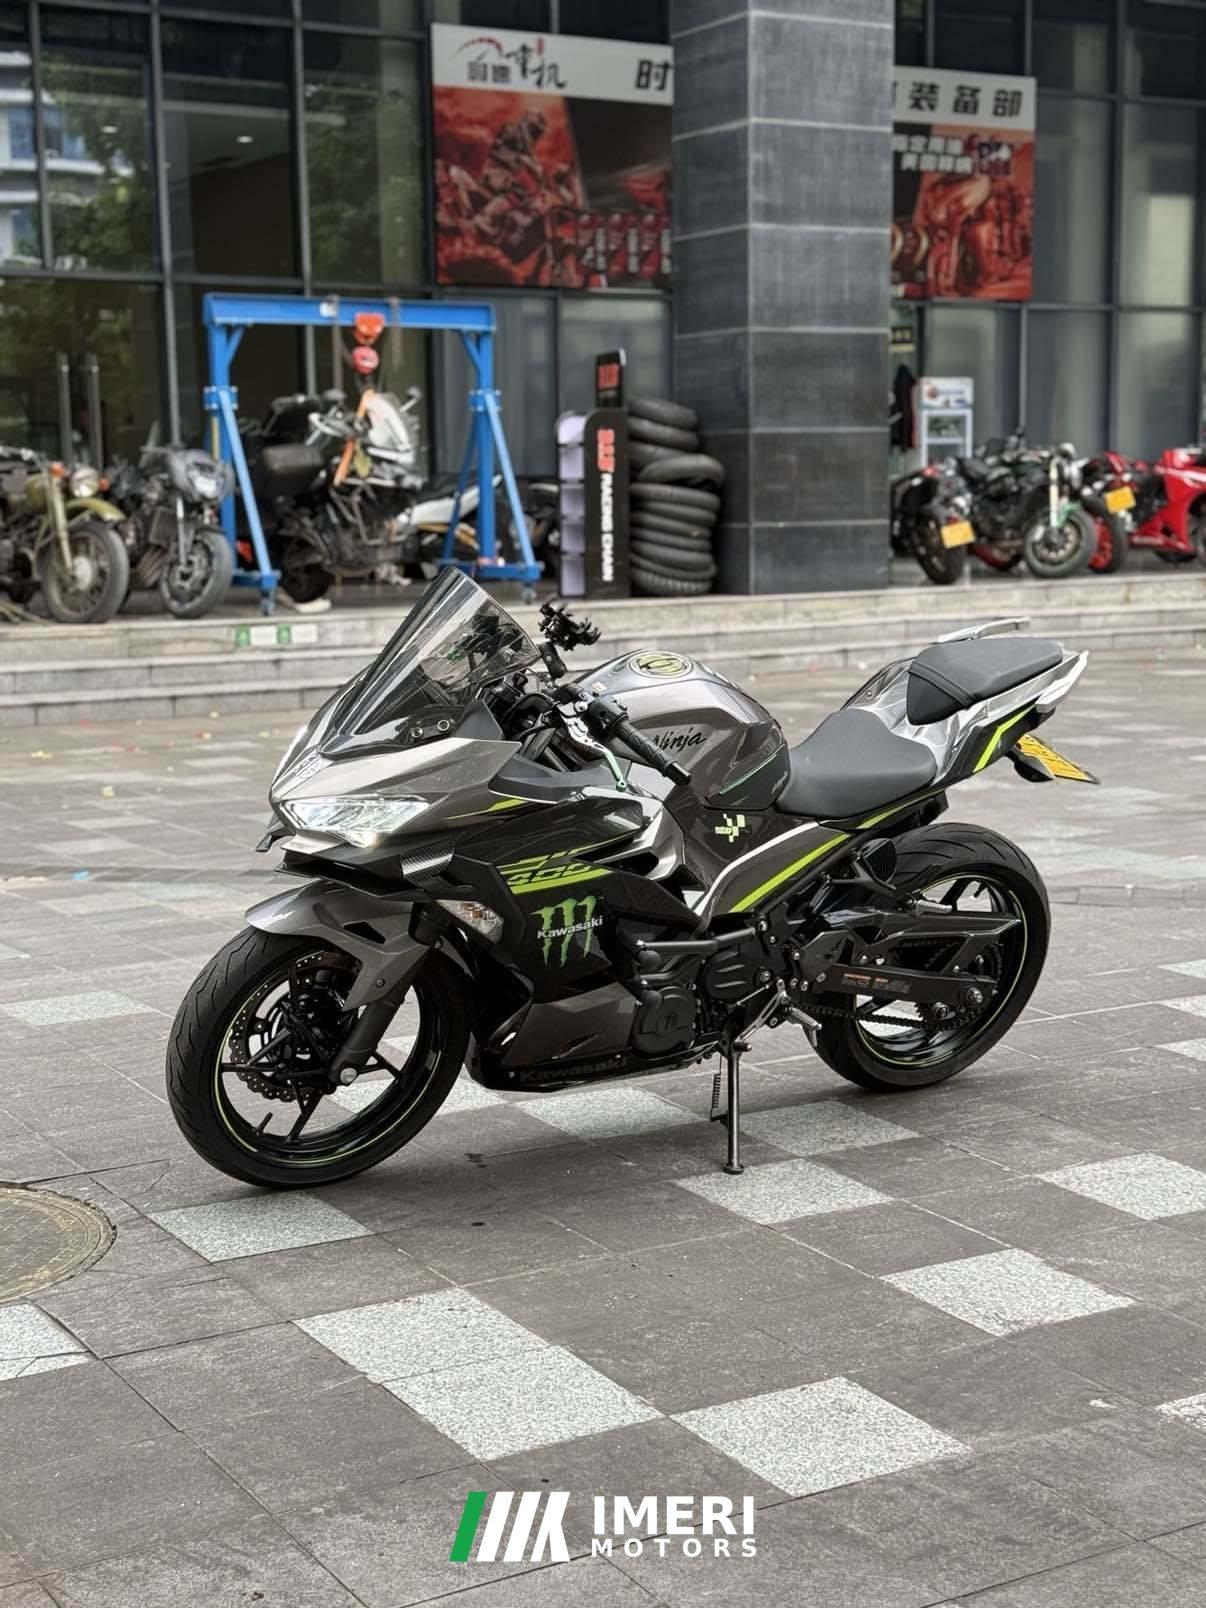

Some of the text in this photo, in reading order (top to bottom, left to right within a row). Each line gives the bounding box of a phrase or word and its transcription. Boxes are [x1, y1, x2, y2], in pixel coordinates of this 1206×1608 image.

[892, 81, 1023, 117] 装备部
[536, 915, 603, 939] Kawasaki
[519, 1055, 629, 1083] Kawasaki
